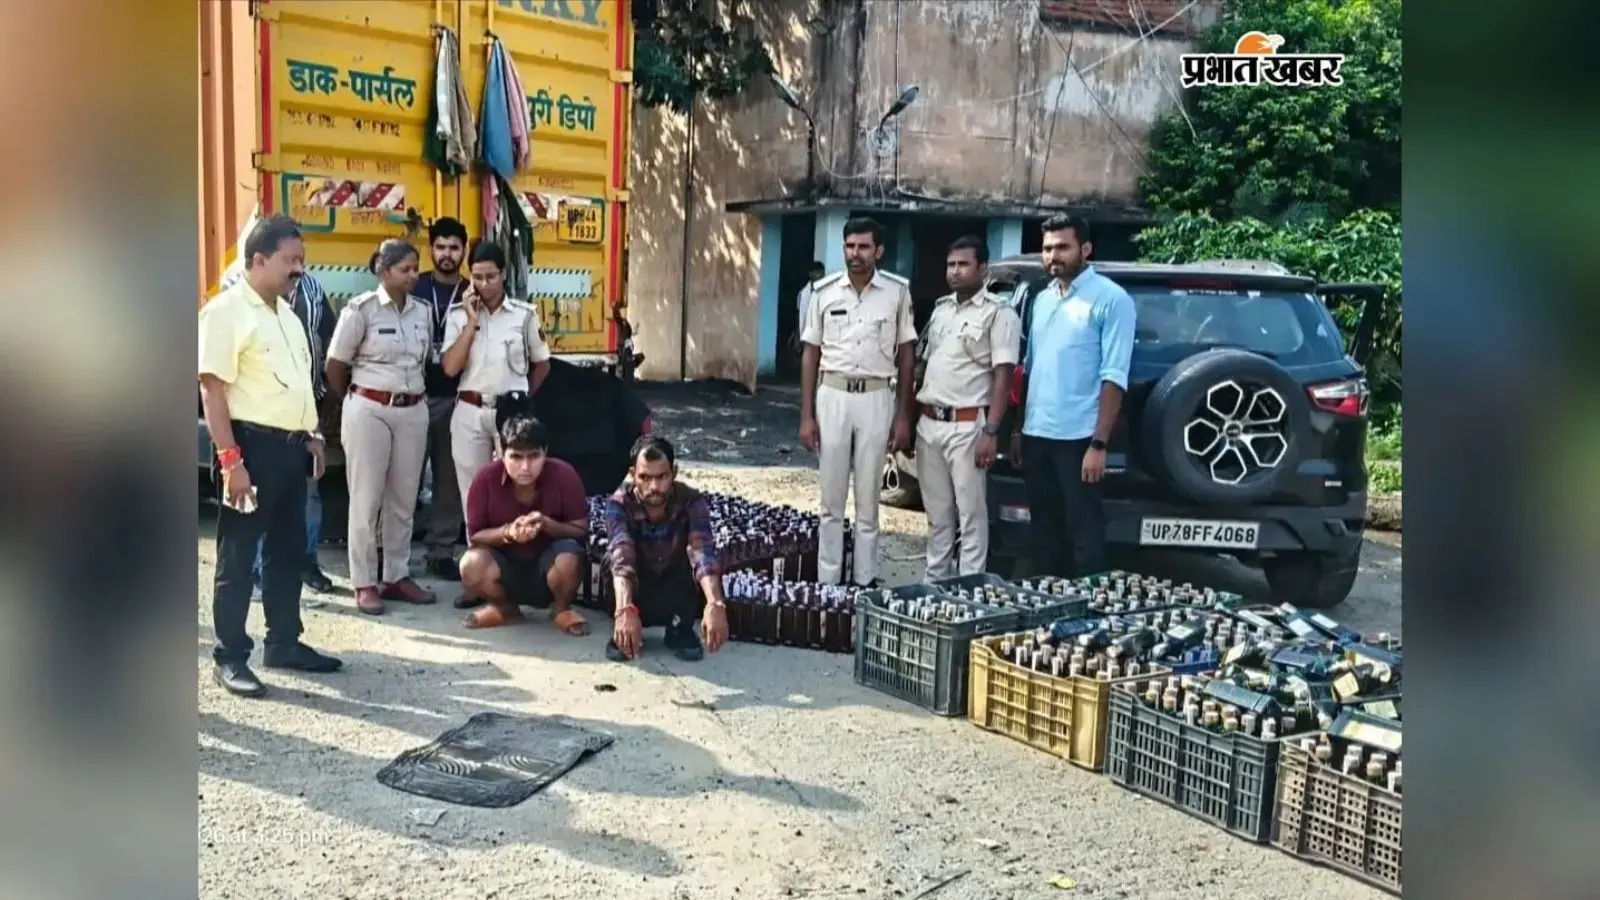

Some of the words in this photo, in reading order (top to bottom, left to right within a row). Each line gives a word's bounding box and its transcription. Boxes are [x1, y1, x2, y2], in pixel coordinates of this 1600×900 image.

[286, 58, 416, 112] डाक-पार्सल
[557, 94, 596, 131] डिपो
[1151, 523, 1255, 543] UP78FF4068
